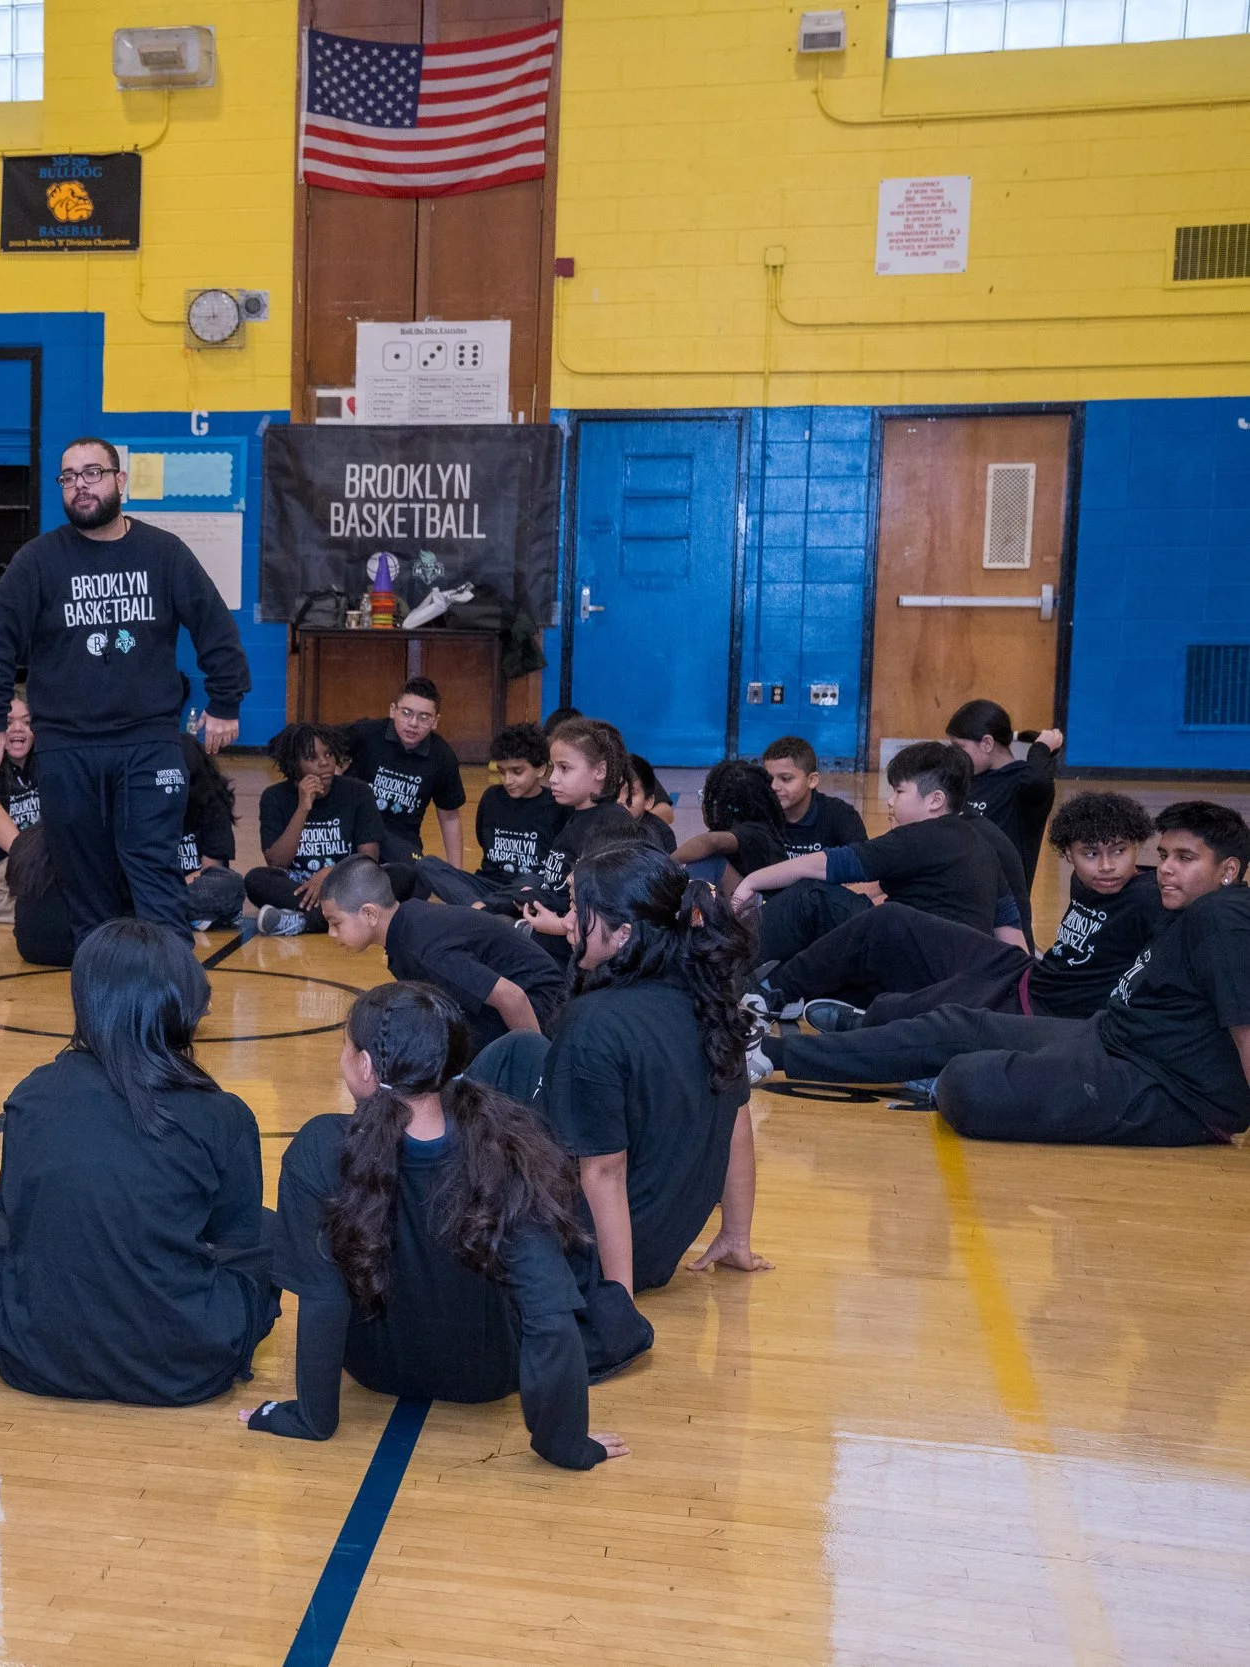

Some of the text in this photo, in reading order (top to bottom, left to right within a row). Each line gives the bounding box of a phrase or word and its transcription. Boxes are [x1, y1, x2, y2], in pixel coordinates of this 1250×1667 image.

[38, 167, 103, 178] BULLDOG
[39, 226, 104, 237] BASEBALL
[191, 410, 209, 436] G
[344, 463, 471, 499] BROOKLYN
[330, 502, 487, 539] BASKETBALL
[71, 570, 149, 600] BROOKLYN
[64, 597, 156, 627] BASKETBALL
[155, 776, 186, 786] BASKETBALL
[156, 768, 182, 778] BROOKLYN
[373, 774, 419, 796] BROOKLYN
[494, 837, 536, 855] BROOKLYN
